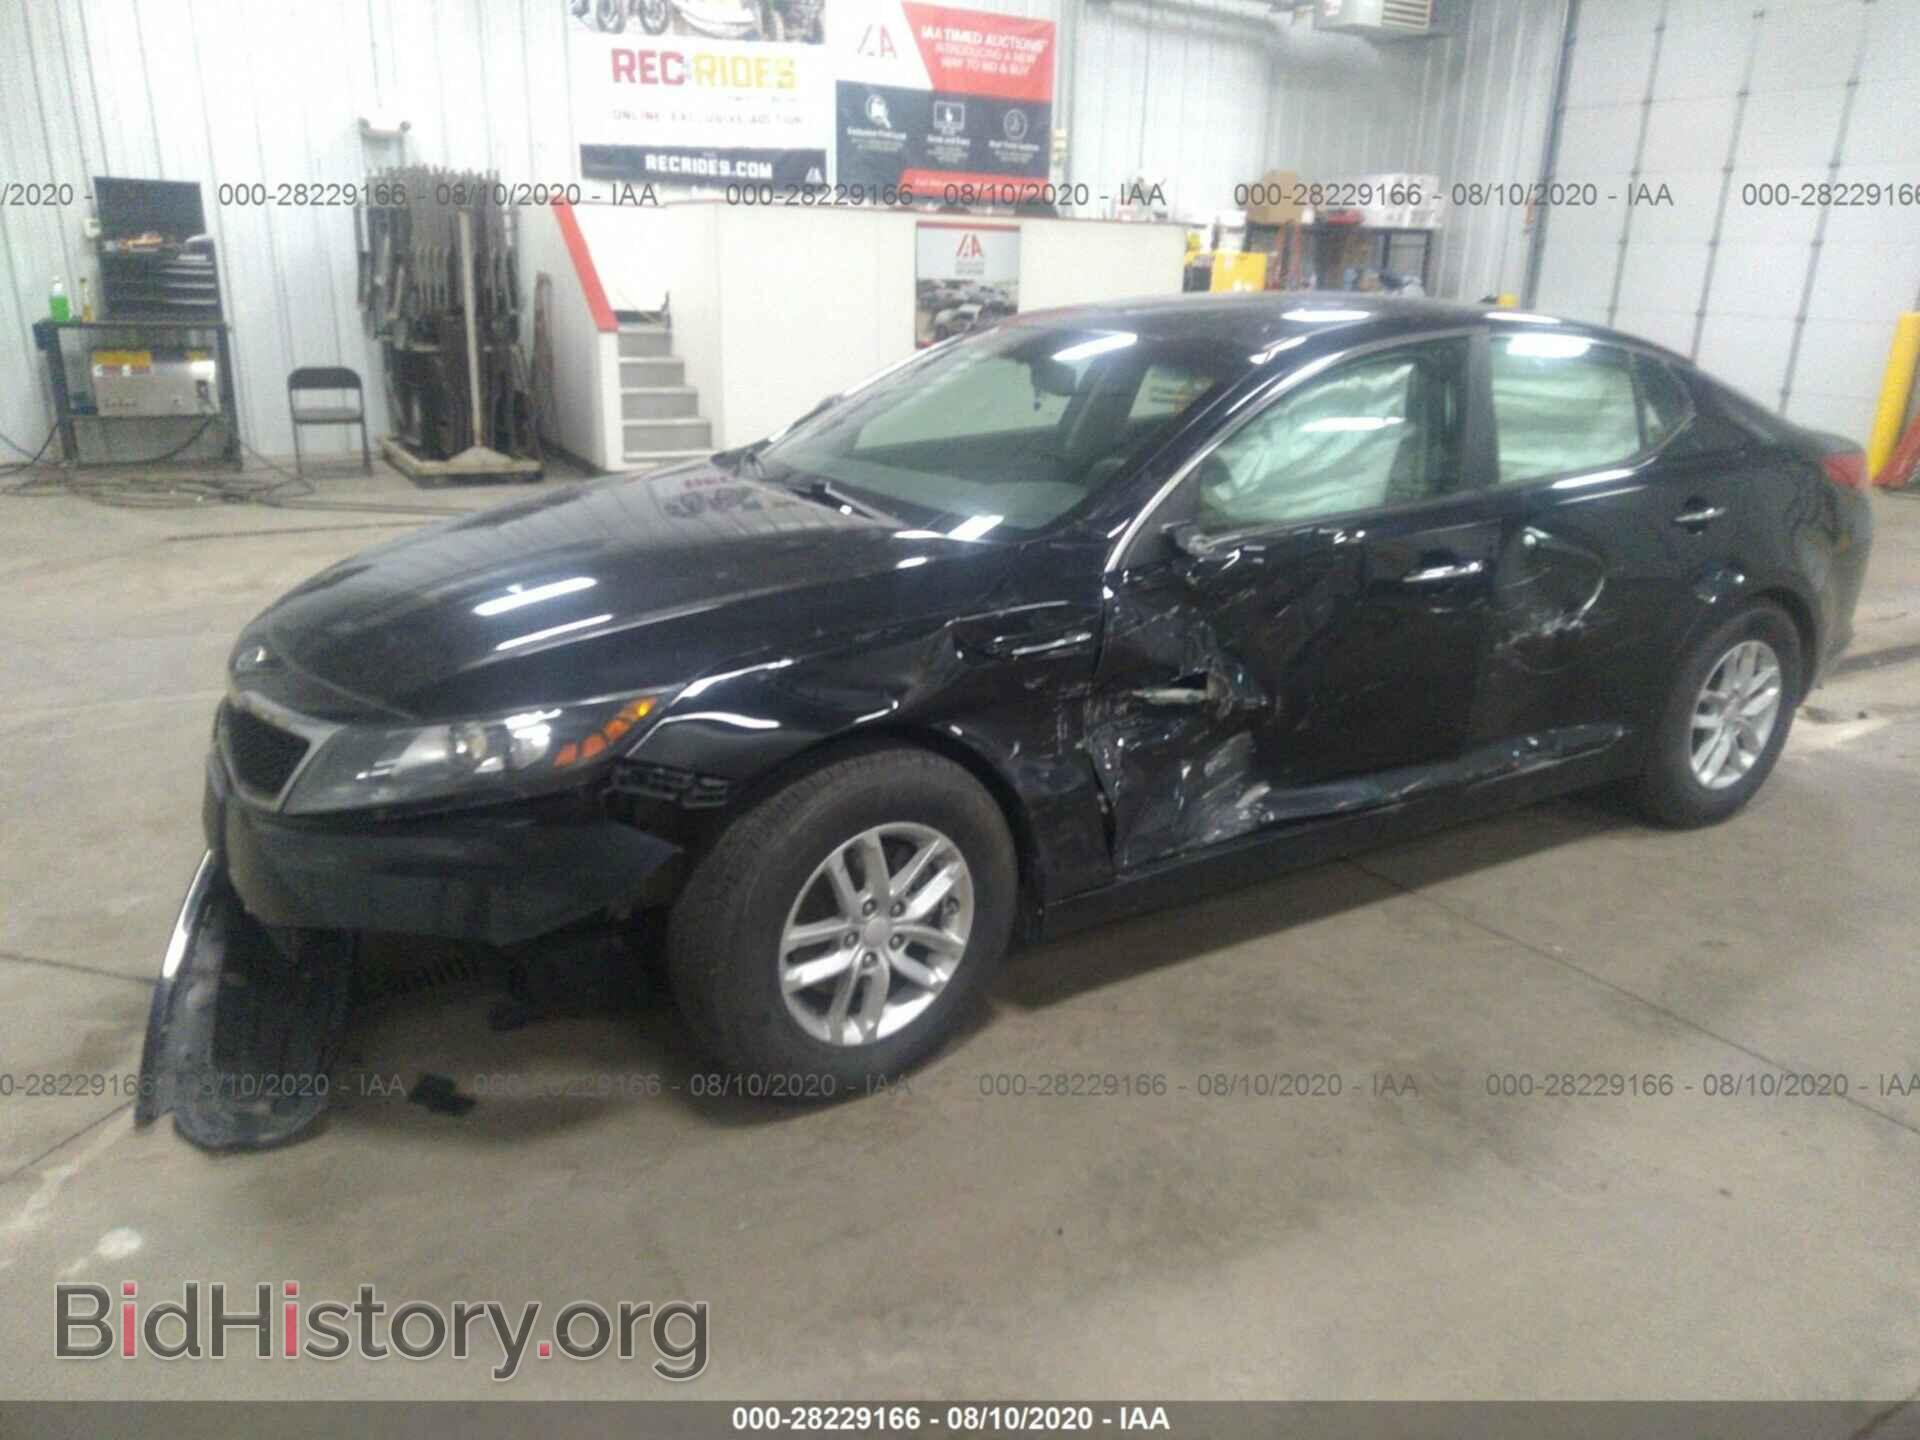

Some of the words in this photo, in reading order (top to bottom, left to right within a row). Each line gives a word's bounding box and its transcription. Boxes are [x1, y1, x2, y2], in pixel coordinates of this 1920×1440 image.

[611, 48, 685, 86] REC
[692, 53, 796, 91] RIDES
[645, 153, 773, 180] RECRIDES.COM
